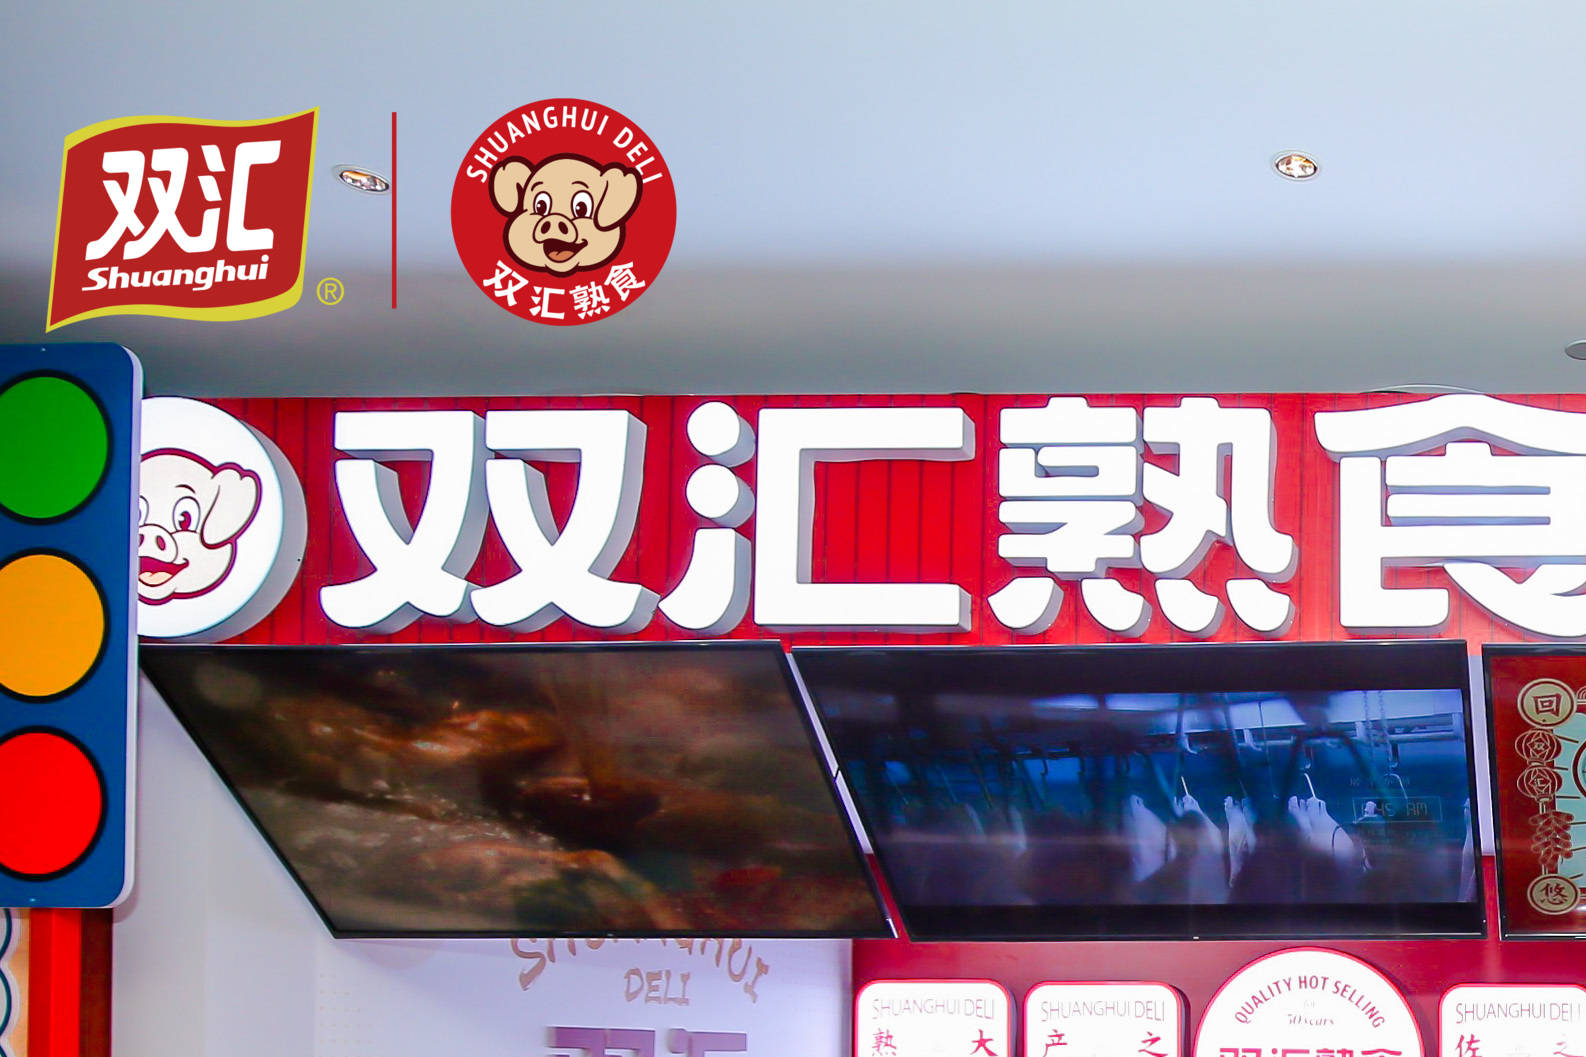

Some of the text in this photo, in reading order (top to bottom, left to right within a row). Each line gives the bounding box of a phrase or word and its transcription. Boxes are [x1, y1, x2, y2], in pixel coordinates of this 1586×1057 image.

[1533, 693, 1562, 718] 回
[1541, 883, 1567, 905] 悠
[624, 968, 690, 1005] DELI
[872, 998, 994, 1020] SHUANGHUI DELI
[1041, 1000, 1165, 1022] SHUANGHUI DELI
[1234, 975, 1386, 1028] QUALITY HOT SELLING
[1455, 1003, 1546, 1024] SHUANGHUI
